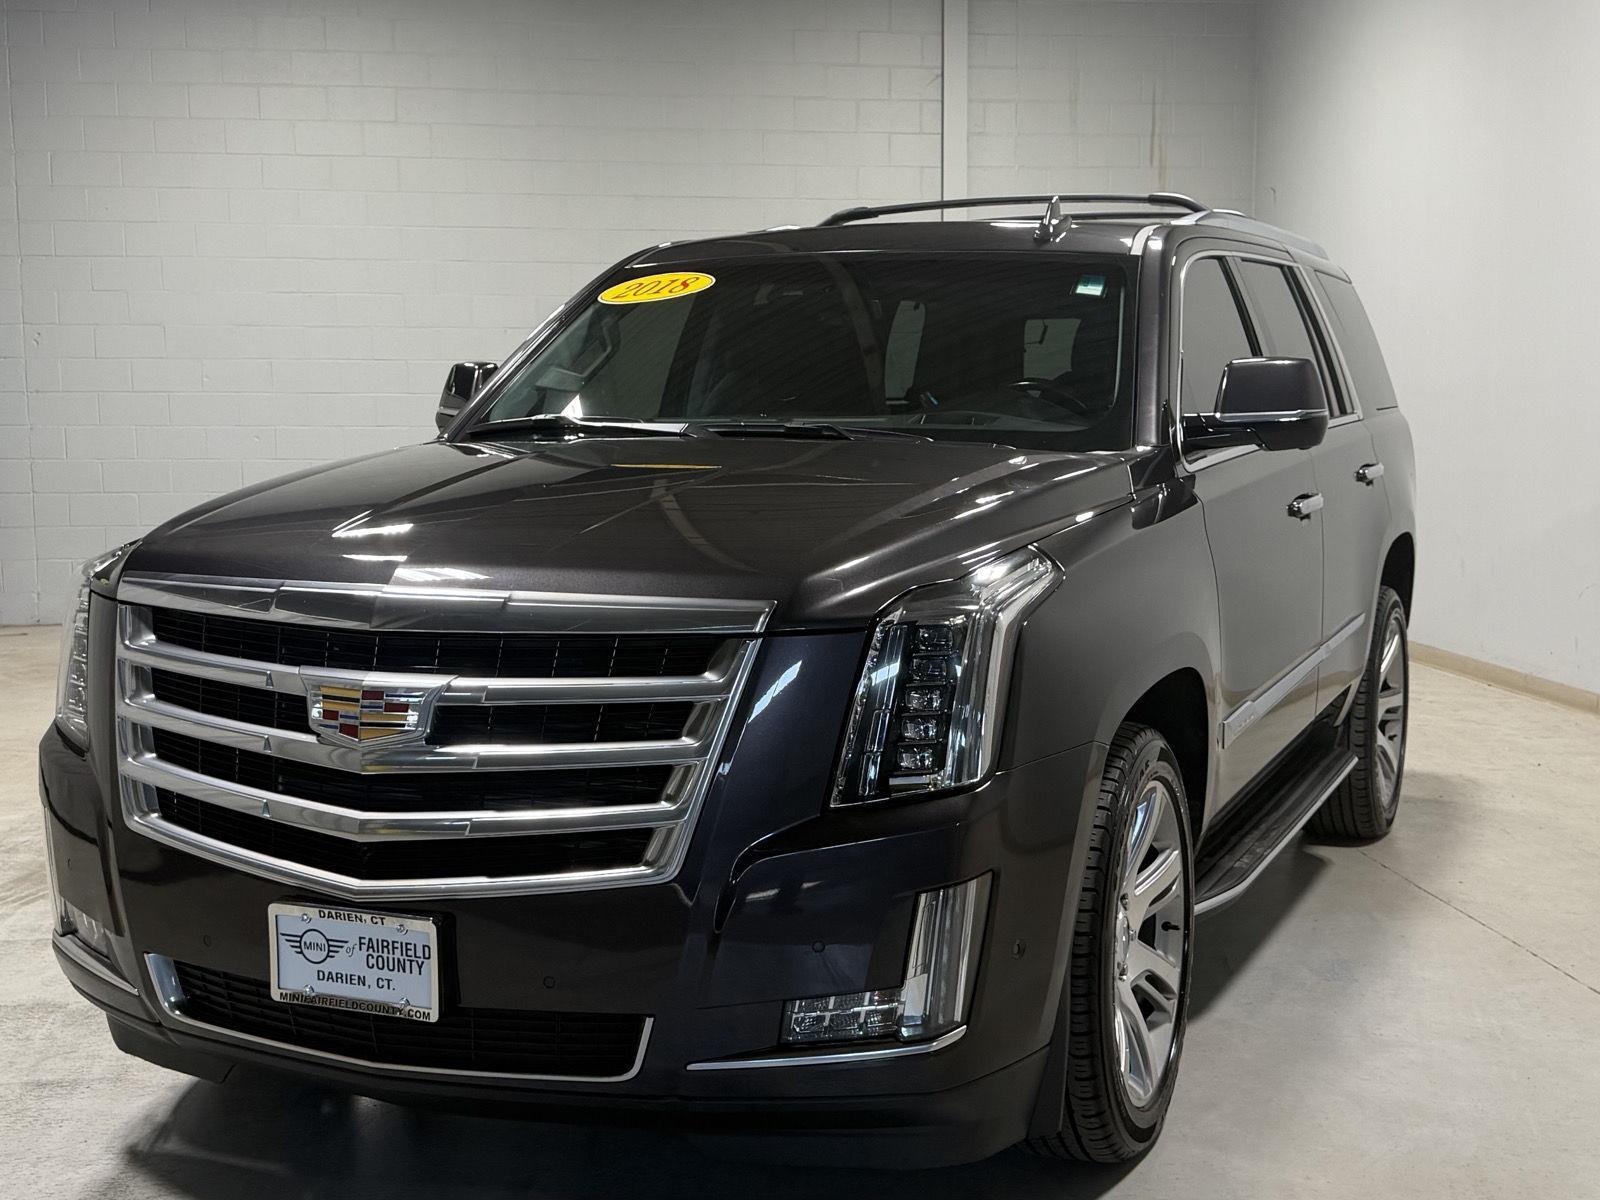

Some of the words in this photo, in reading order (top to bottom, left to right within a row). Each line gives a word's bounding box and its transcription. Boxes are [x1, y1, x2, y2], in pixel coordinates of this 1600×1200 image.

[610, 276, 700, 299] 2018
[318, 909, 367, 924] DARIEN,
[371, 915, 386, 926] CT
[303, 941, 326, 952] MINI
[345, 943, 358, 958] of
[358, 936, 431, 960] FAIRFIELD
[366, 953, 425, 976] COUNTY
[316, 969, 371, 989] DARIEN,
[376, 977, 396, 991] CT.
